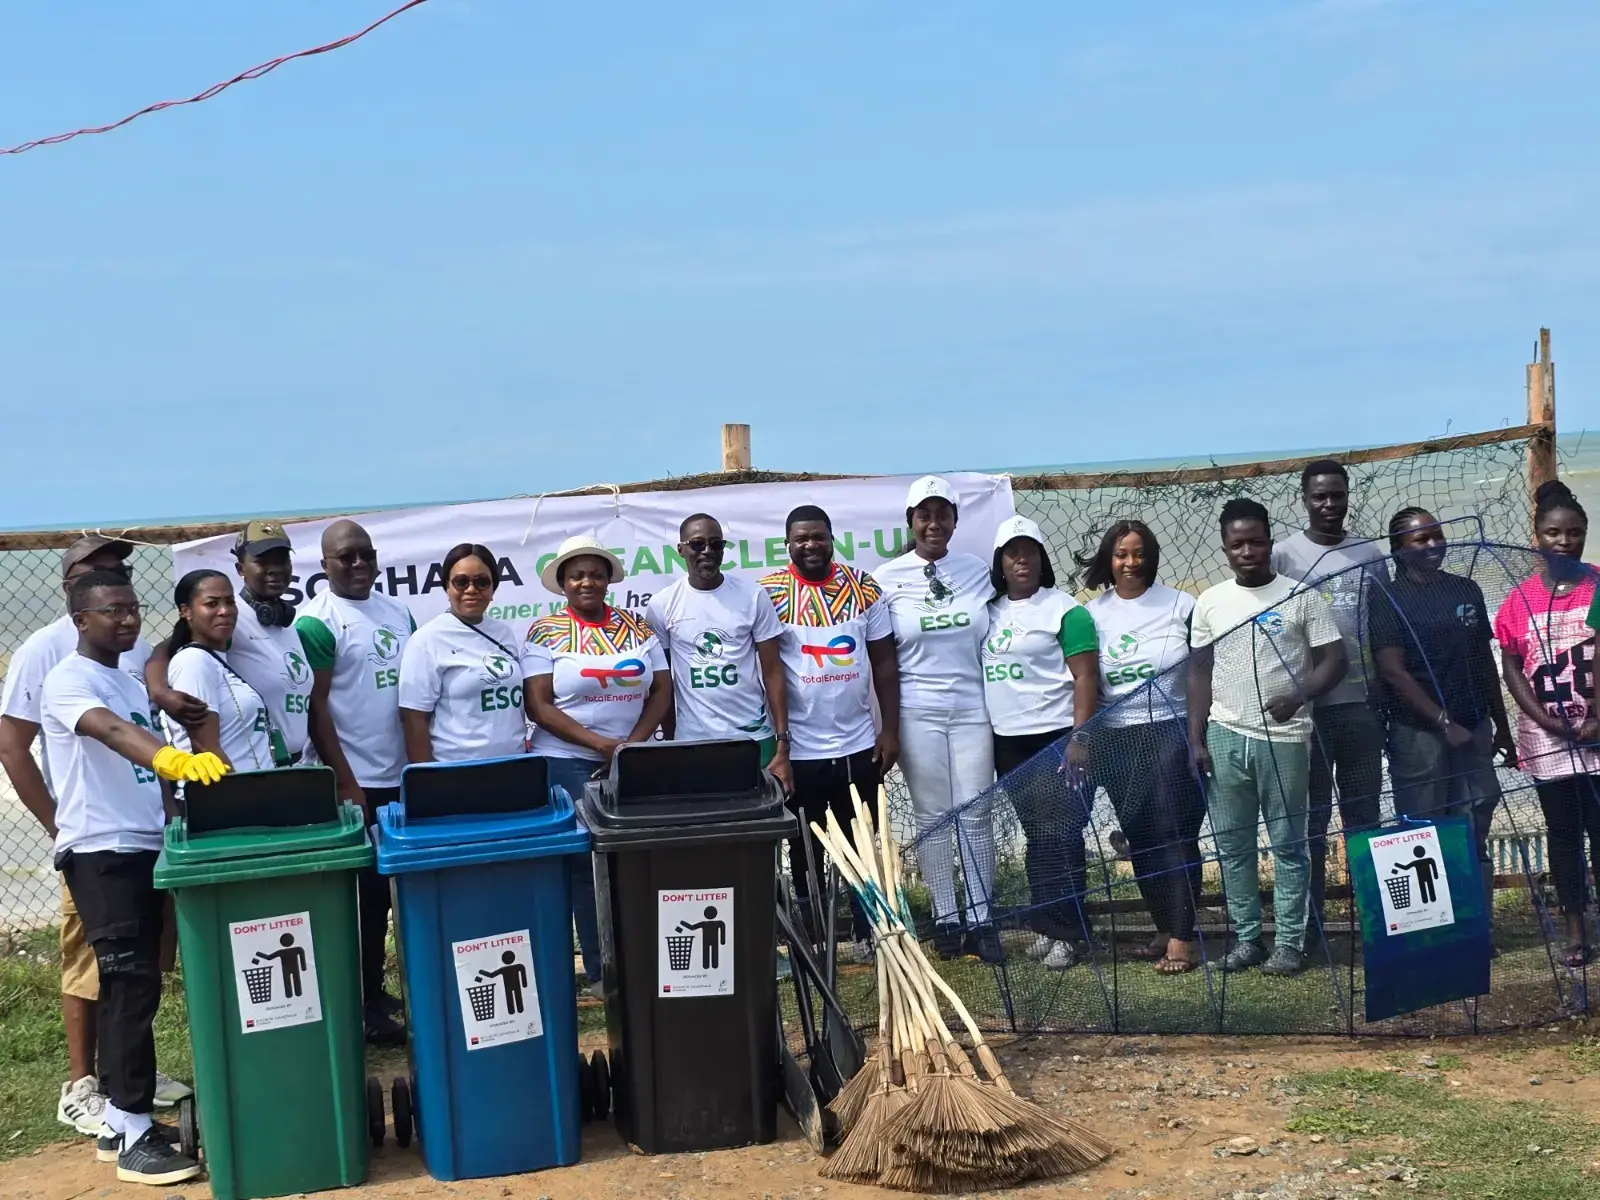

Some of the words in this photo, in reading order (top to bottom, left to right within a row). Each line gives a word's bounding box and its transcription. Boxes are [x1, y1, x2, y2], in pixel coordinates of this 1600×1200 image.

[920, 612, 971, 632] ESG
[690, 664, 738, 689] ESG
[801, 671, 860, 684] TotalEnergies
[985, 663, 1024, 682] ESG
[1106, 663, 1156, 687] ESG
[583, 692, 642, 703] TotalEnergies
[1373, 838, 1401, 849] DON'T
[1402, 831, 1432, 843] LITTER
[662, 894, 693, 902] DON'T
[695, 892, 728, 901] LITTER
[234, 923, 266, 935] DON'T
[269, 917, 304, 930] LITTER
[457, 942, 488, 954] DON'T
[491, 935, 524, 948] LITTER
